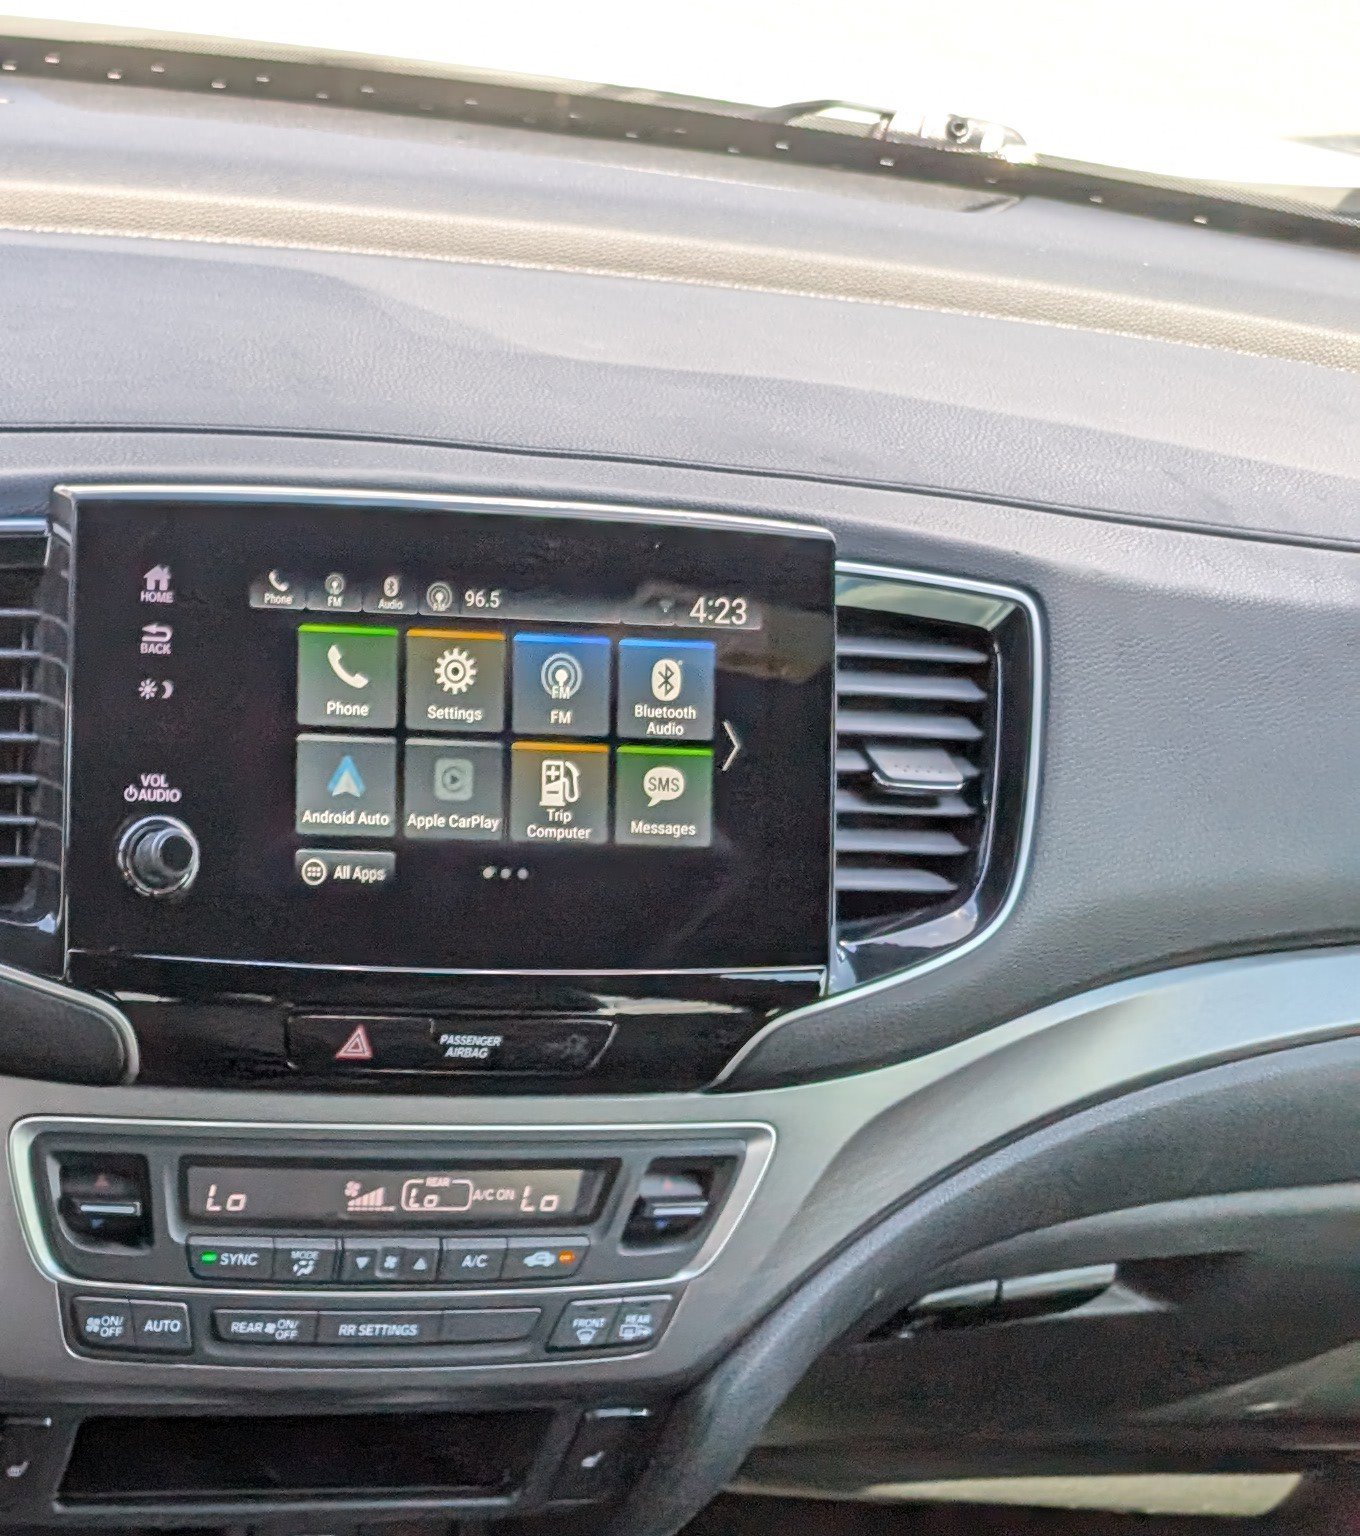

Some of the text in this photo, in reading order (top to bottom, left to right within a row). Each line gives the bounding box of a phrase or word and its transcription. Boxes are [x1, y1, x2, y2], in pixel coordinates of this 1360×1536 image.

[140, 591, 174, 603] HOME
[264, 593, 293, 605] Phone
[327, 595, 343, 607] FM
[378, 599, 404, 610] Audio
[464, 589, 501, 609] 96.5
[689, 596, 748, 625] 4:23
[140, 642, 172, 655] BACK
[551, 686, 571, 700] FM
[326, 700, 370, 717] Phone
[426, 705, 483, 723] Settings
[634, 704, 697, 720] Bluetooth
[550, 710, 572, 724] FM
[646, 720, 685, 736] Audio
[140, 772, 169, 788] VOL
[647, 776, 681, 793] SMS
[138, 787, 182, 803] AUDIO
[301, 809, 390, 826] Android Auto
[406, 813, 501, 833] Apple CarPlay
[546, 808, 573, 824] Trip
[526, 825, 593, 841] Computer
[630, 820, 697, 839] Messages
[333, 865, 387, 884] All Apps
[439, 1033, 503, 1047] PASSENGER
[444, 1047, 489, 1059] AIRBAG
[206, 1183, 247, 1212] Lo
[496, 1188, 515, 1201] ON
[219, 1252, 260, 1266] SYNC
[461, 1253, 489, 1268] A/C
[100, 1325, 124, 1338] OFF
[143, 1319, 181, 1333] AUTO
[230, 1321, 262, 1334] REAR
[337, 1323, 419, 1338] RR SETTINGS
[275, 1329, 299, 1342] OFF
